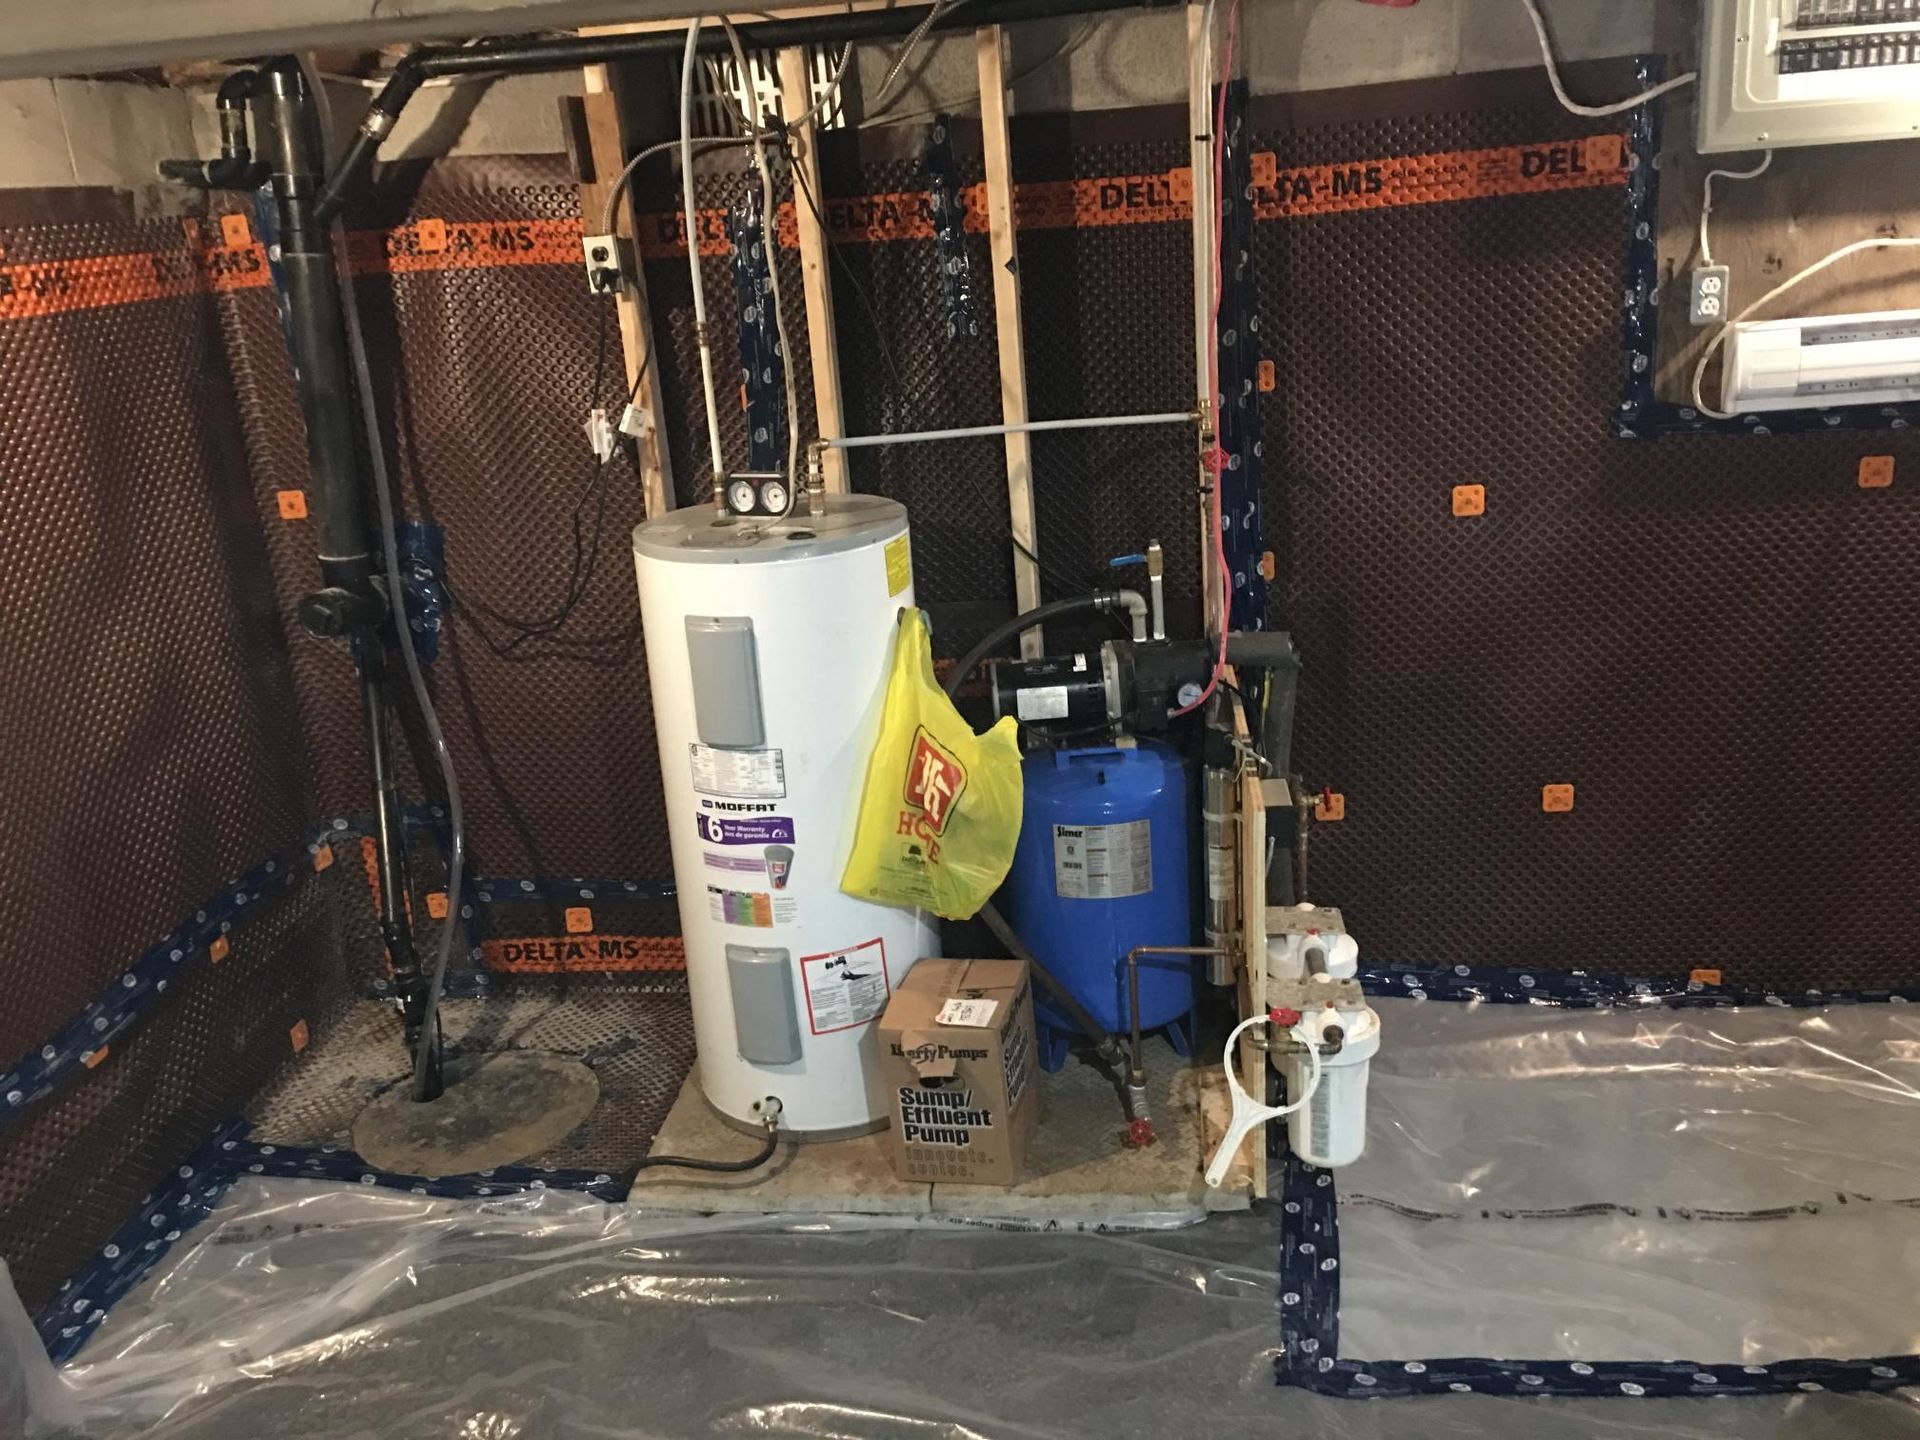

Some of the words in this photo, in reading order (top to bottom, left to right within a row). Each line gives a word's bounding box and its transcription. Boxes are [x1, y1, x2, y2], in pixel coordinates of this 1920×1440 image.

[715, 801, 777, 812] MOFFAT
[708, 815, 724, 843] 6
[1057, 825, 1084, 838] Simer
[937, 1043, 989, 1061] Pumps
[899, 1087, 973, 1110] Sump/
[901, 1106, 993, 1127] Effluent
[904, 1125, 970, 1145] Pump
